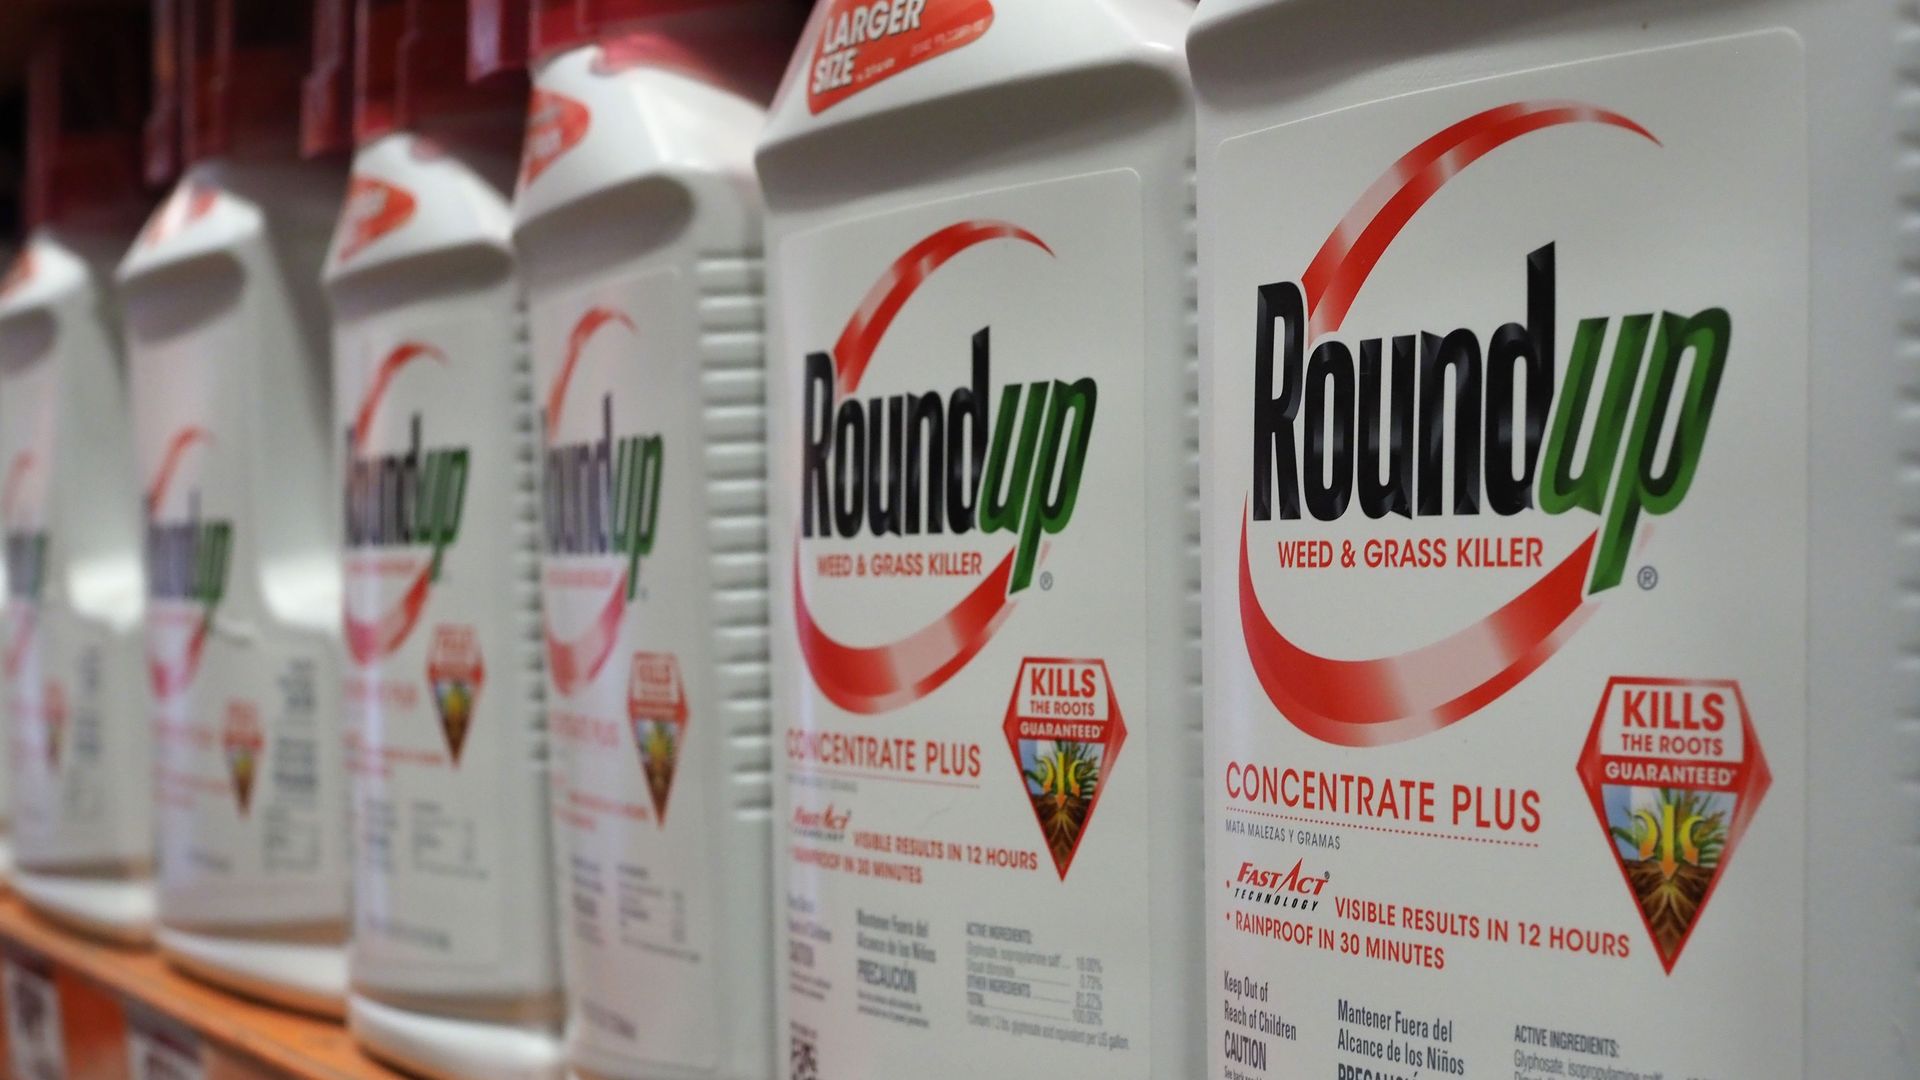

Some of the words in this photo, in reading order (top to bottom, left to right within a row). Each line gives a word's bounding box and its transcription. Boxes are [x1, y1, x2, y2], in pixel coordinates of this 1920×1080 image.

[823, 0, 925, 53] LARGER
[813, 49, 859, 95] SIZE
[1252, 240, 1732, 595] Roundup
[802, 325, 1098, 595] Roundup
[816, 553, 851, 577] WEED
[856, 553, 866, 576] &
[871, 553, 924, 577] GRASS
[928, 551, 983, 576] KILLER
[1278, 539, 1333, 569] WEED
[1341, 540, 1356, 568] &
[1363, 538, 1447, 569] GRASS
[1457, 537, 1544, 568] KILLER
[1031, 667, 1096, 698] KILLS
[1030, 700, 1050, 715] THE
[1054, 701, 1095, 716] ROOTS
[1623, 689, 1725, 732] KILLS
[785, 728, 915, 772] CONCENTRATE
[925, 741, 981, 778] PLUS
[1621, 733, 1653, 753] THE
[1659, 735, 1724, 756] ROOTS
[1226, 761, 1435, 823] CONCENTRATE
[1452, 784, 1541, 833] PLUS
[854, 831, 892, 853] VISIBLE
[895, 836, 945, 860] RESULTS
[947, 843, 962, 862] IN
[966, 845, 982, 864] 12
[986, 848, 1038, 871] HOURS
[1225, 819, 1245, 836] MATA
[1247, 823, 1286, 842] MALEZAS
[1289, 830, 1294, 843] Y
[1297, 831, 1341, 850] GRAMAS
[873, 859, 923, 885] MINUTES
[1234, 888, 1319, 911] TECHNOLOGY
[1235, 911, 1313, 947] RAINPROOF
[1318, 927, 1334, 952] IN
[1340, 932, 1360, 956] 30
[1366, 936, 1445, 971] MINUTES
[1335, 897, 1396, 927] VISIBLE
[1402, 906, 1480, 939] RESULTS
[1487, 919, 1509, 943] IN
[1518, 921, 1541, 947] 12
[1549, 928, 1631, 958] HOURS
[1223, 970, 1242, 1000] Keep
[1244, 976, 1258, 1000] Out
[1260, 981, 1268, 1002] of
[1224, 1000, 1247, 1026] Reach
[1249, 1007, 1258, 1031] of
[1258, 1010, 1297, 1041] Children
[1338, 999, 1392, 1031] Mantener
[1395, 1010, 1429, 1039] Fuera
[1432, 1017, 1453, 1043] del
[1224, 1029, 1267, 1071] CAUTION
[1338, 1028, 1383, 1060] Alcance
[1386, 1037, 1401, 1063] de
[1404, 1041, 1423, 1068] los
[1426, 1046, 1465, 1076] Niños
[1514, 1025, 1548, 1047] ACTIVE
[1549, 1030, 1620, 1058] INGREDIENTS:
